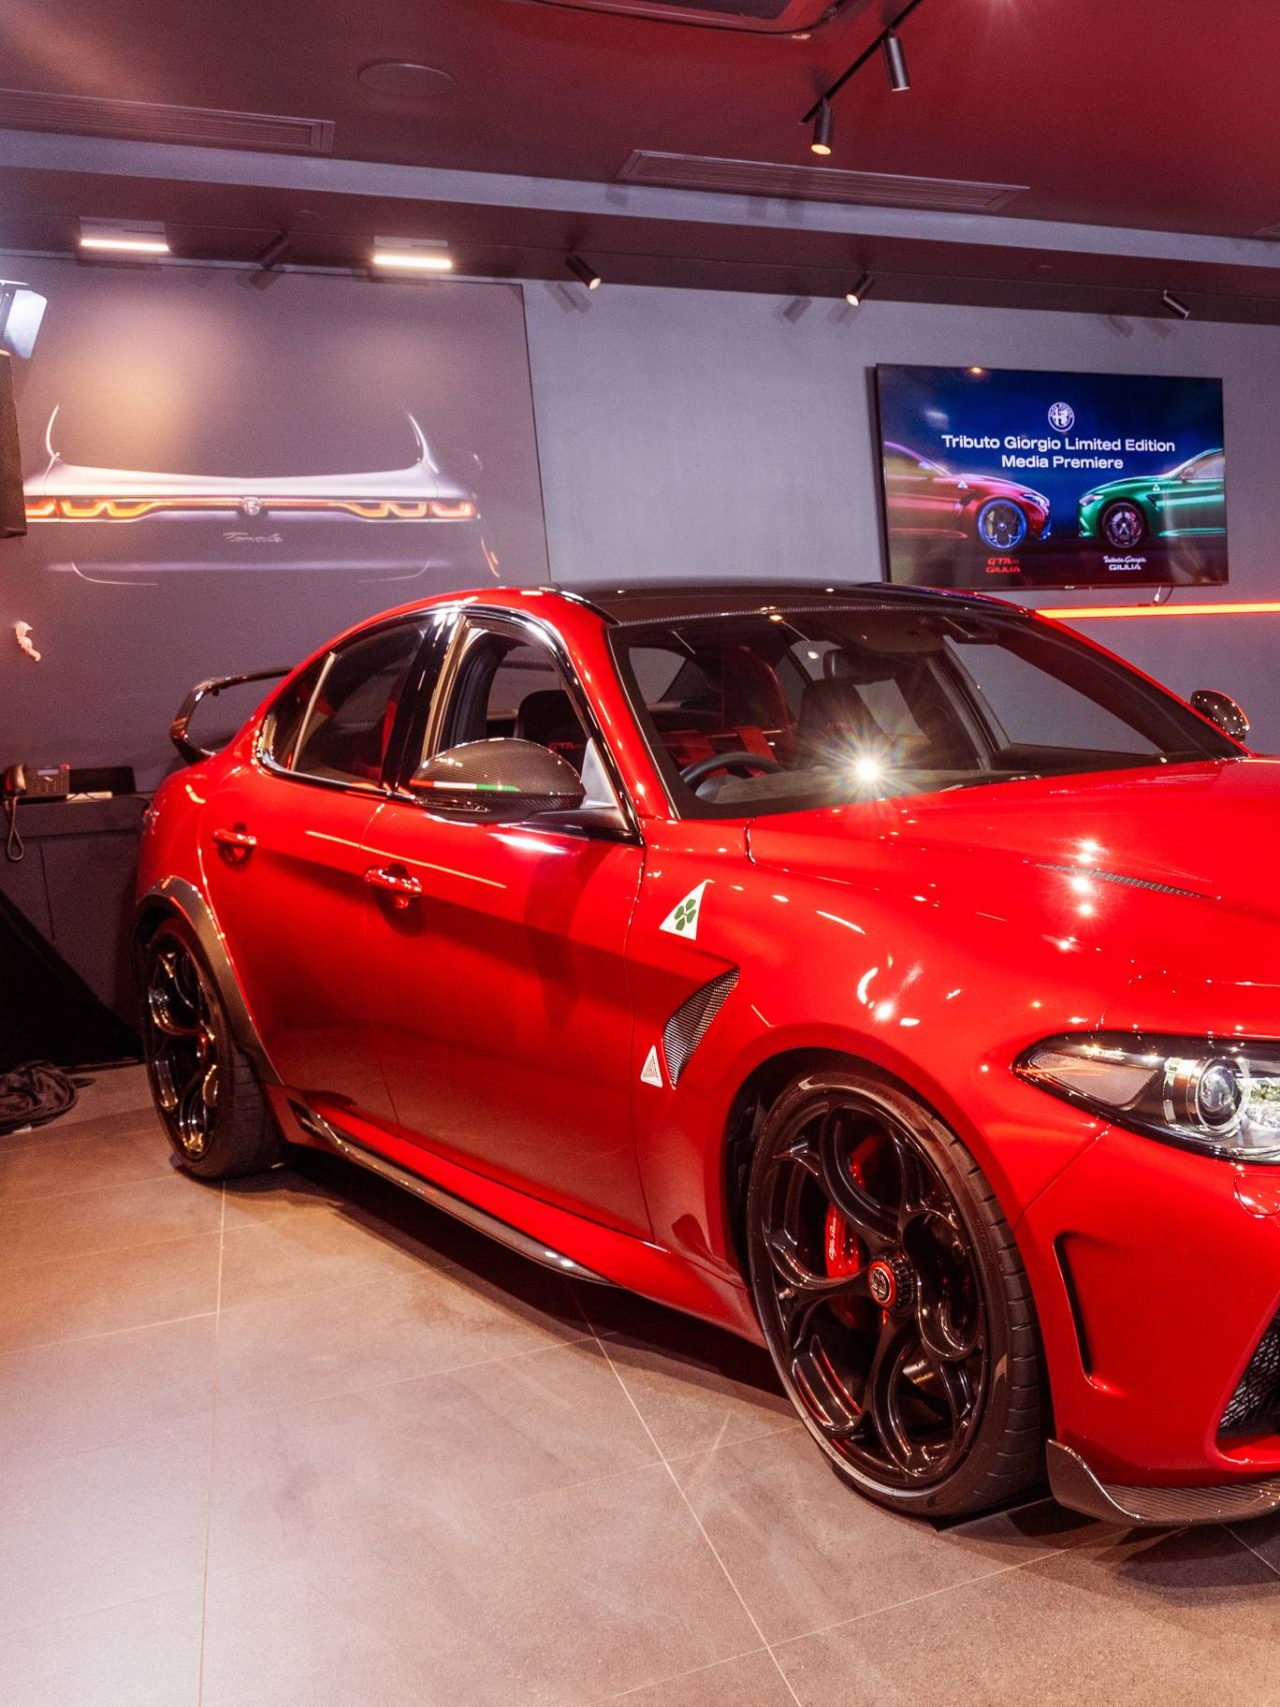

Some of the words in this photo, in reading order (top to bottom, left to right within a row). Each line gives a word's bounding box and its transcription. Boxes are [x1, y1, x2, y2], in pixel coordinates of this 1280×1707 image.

[941, 434, 1000, 449] Tributo
[1004, 436, 1061, 452] Giorgio
[1065, 437, 1121, 451] Limited
[1125, 438, 1175, 452] Edition
[1001, 454, 1049, 468] Media
[1053, 455, 1124, 469] Premiere
[1108, 563, 1142, 571] GIULIA
